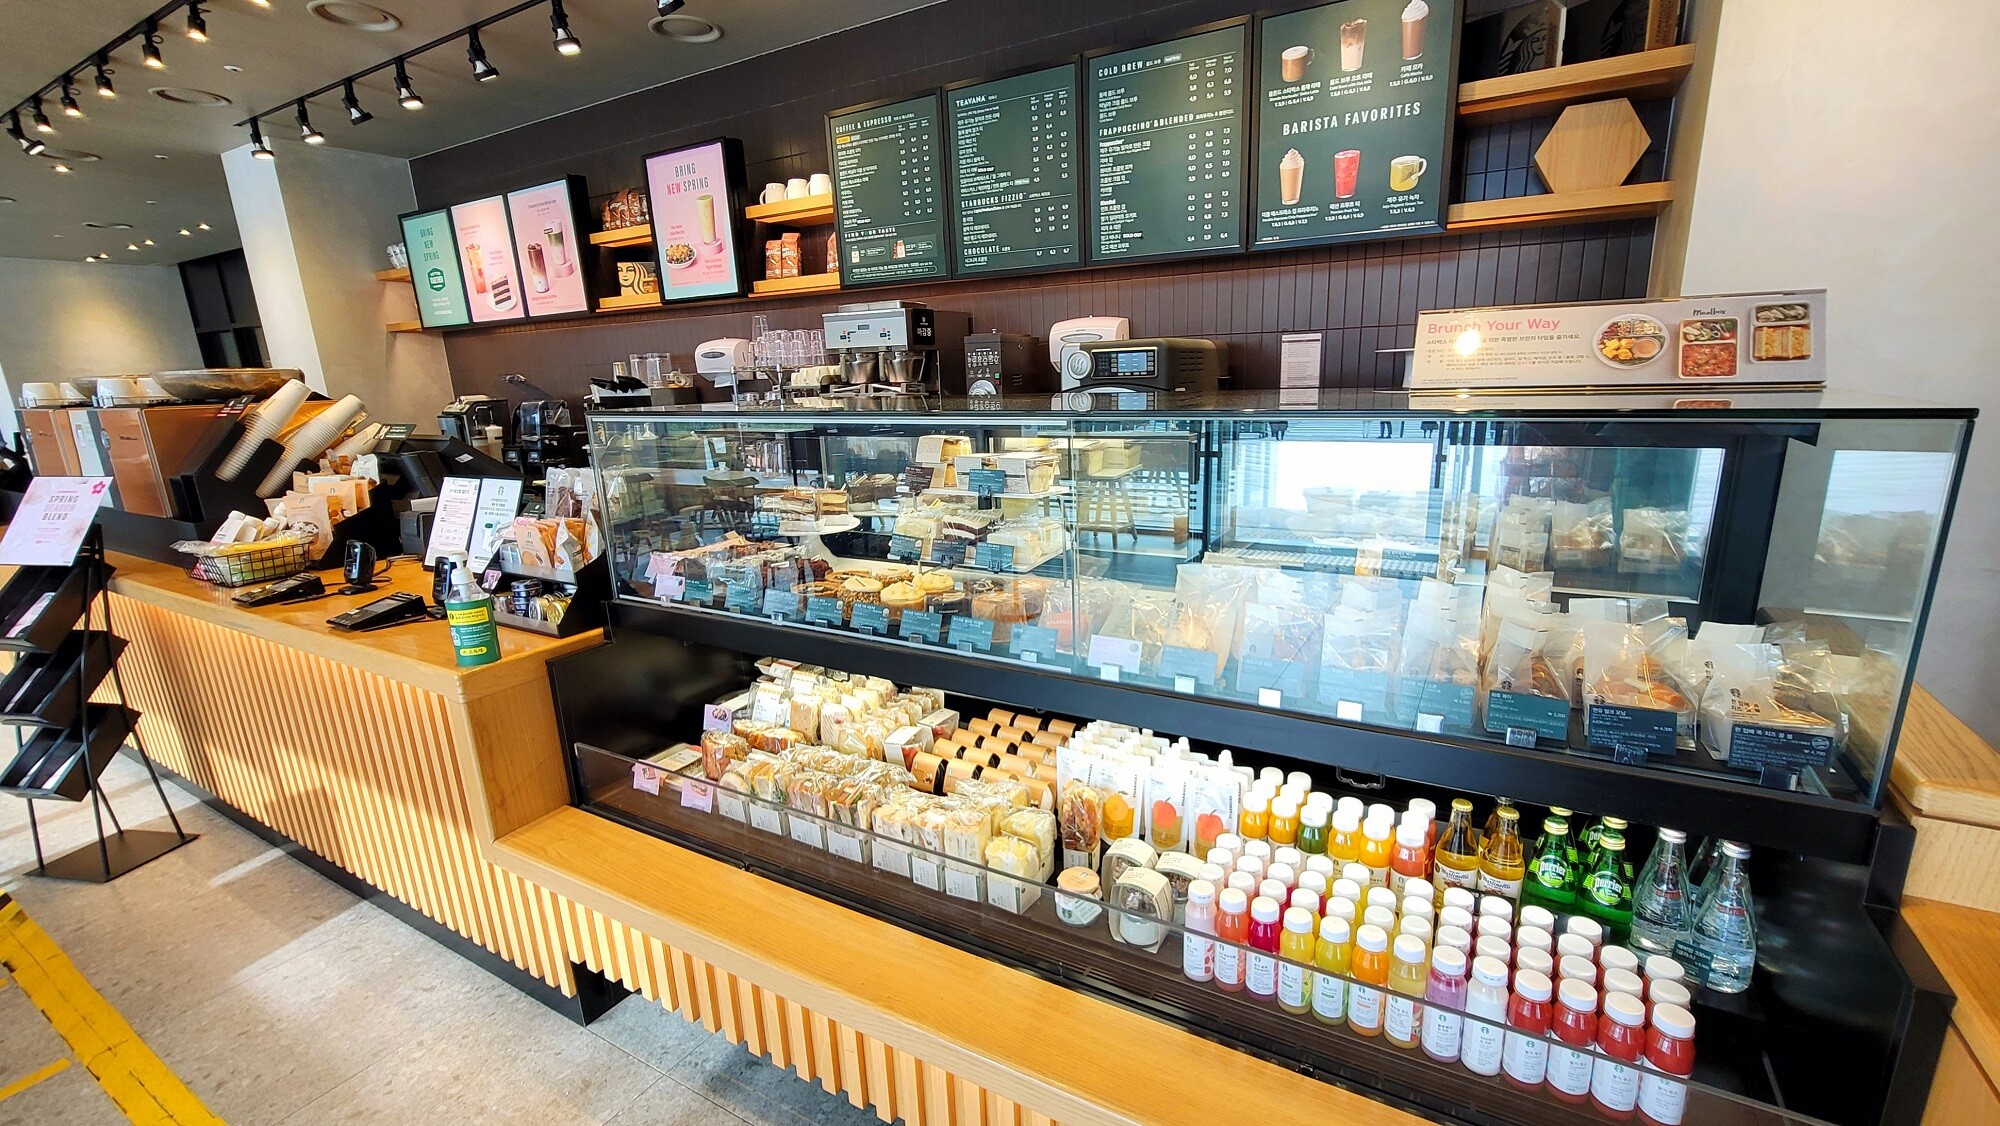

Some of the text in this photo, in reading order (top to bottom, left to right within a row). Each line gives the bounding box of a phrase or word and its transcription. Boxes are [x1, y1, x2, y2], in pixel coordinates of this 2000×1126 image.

[1098, 61, 1144, 77] COLD BREW
[956, 96, 986, 107] TEAVANA
[836, 123, 856, 133] COFFEE
[863, 115, 892, 127] ESPRESSO
[1099, 114, 1194, 136] FRAPPUCCINO & BLENDED
[1283, 102, 1421, 136] BARISTA FAVORITES
[675, 163, 696, 177] BRING
[666, 177, 709, 195] NEW SPRING
[961, 196, 998, 208] STARBUCKS
[1001, 193, 1023, 202] FIZZIO
[964, 246, 1000, 255] CHOCOLATE
[917, 328, 932, 337] 마감중
[1428, 318, 1560, 334] Brunch Your Way
